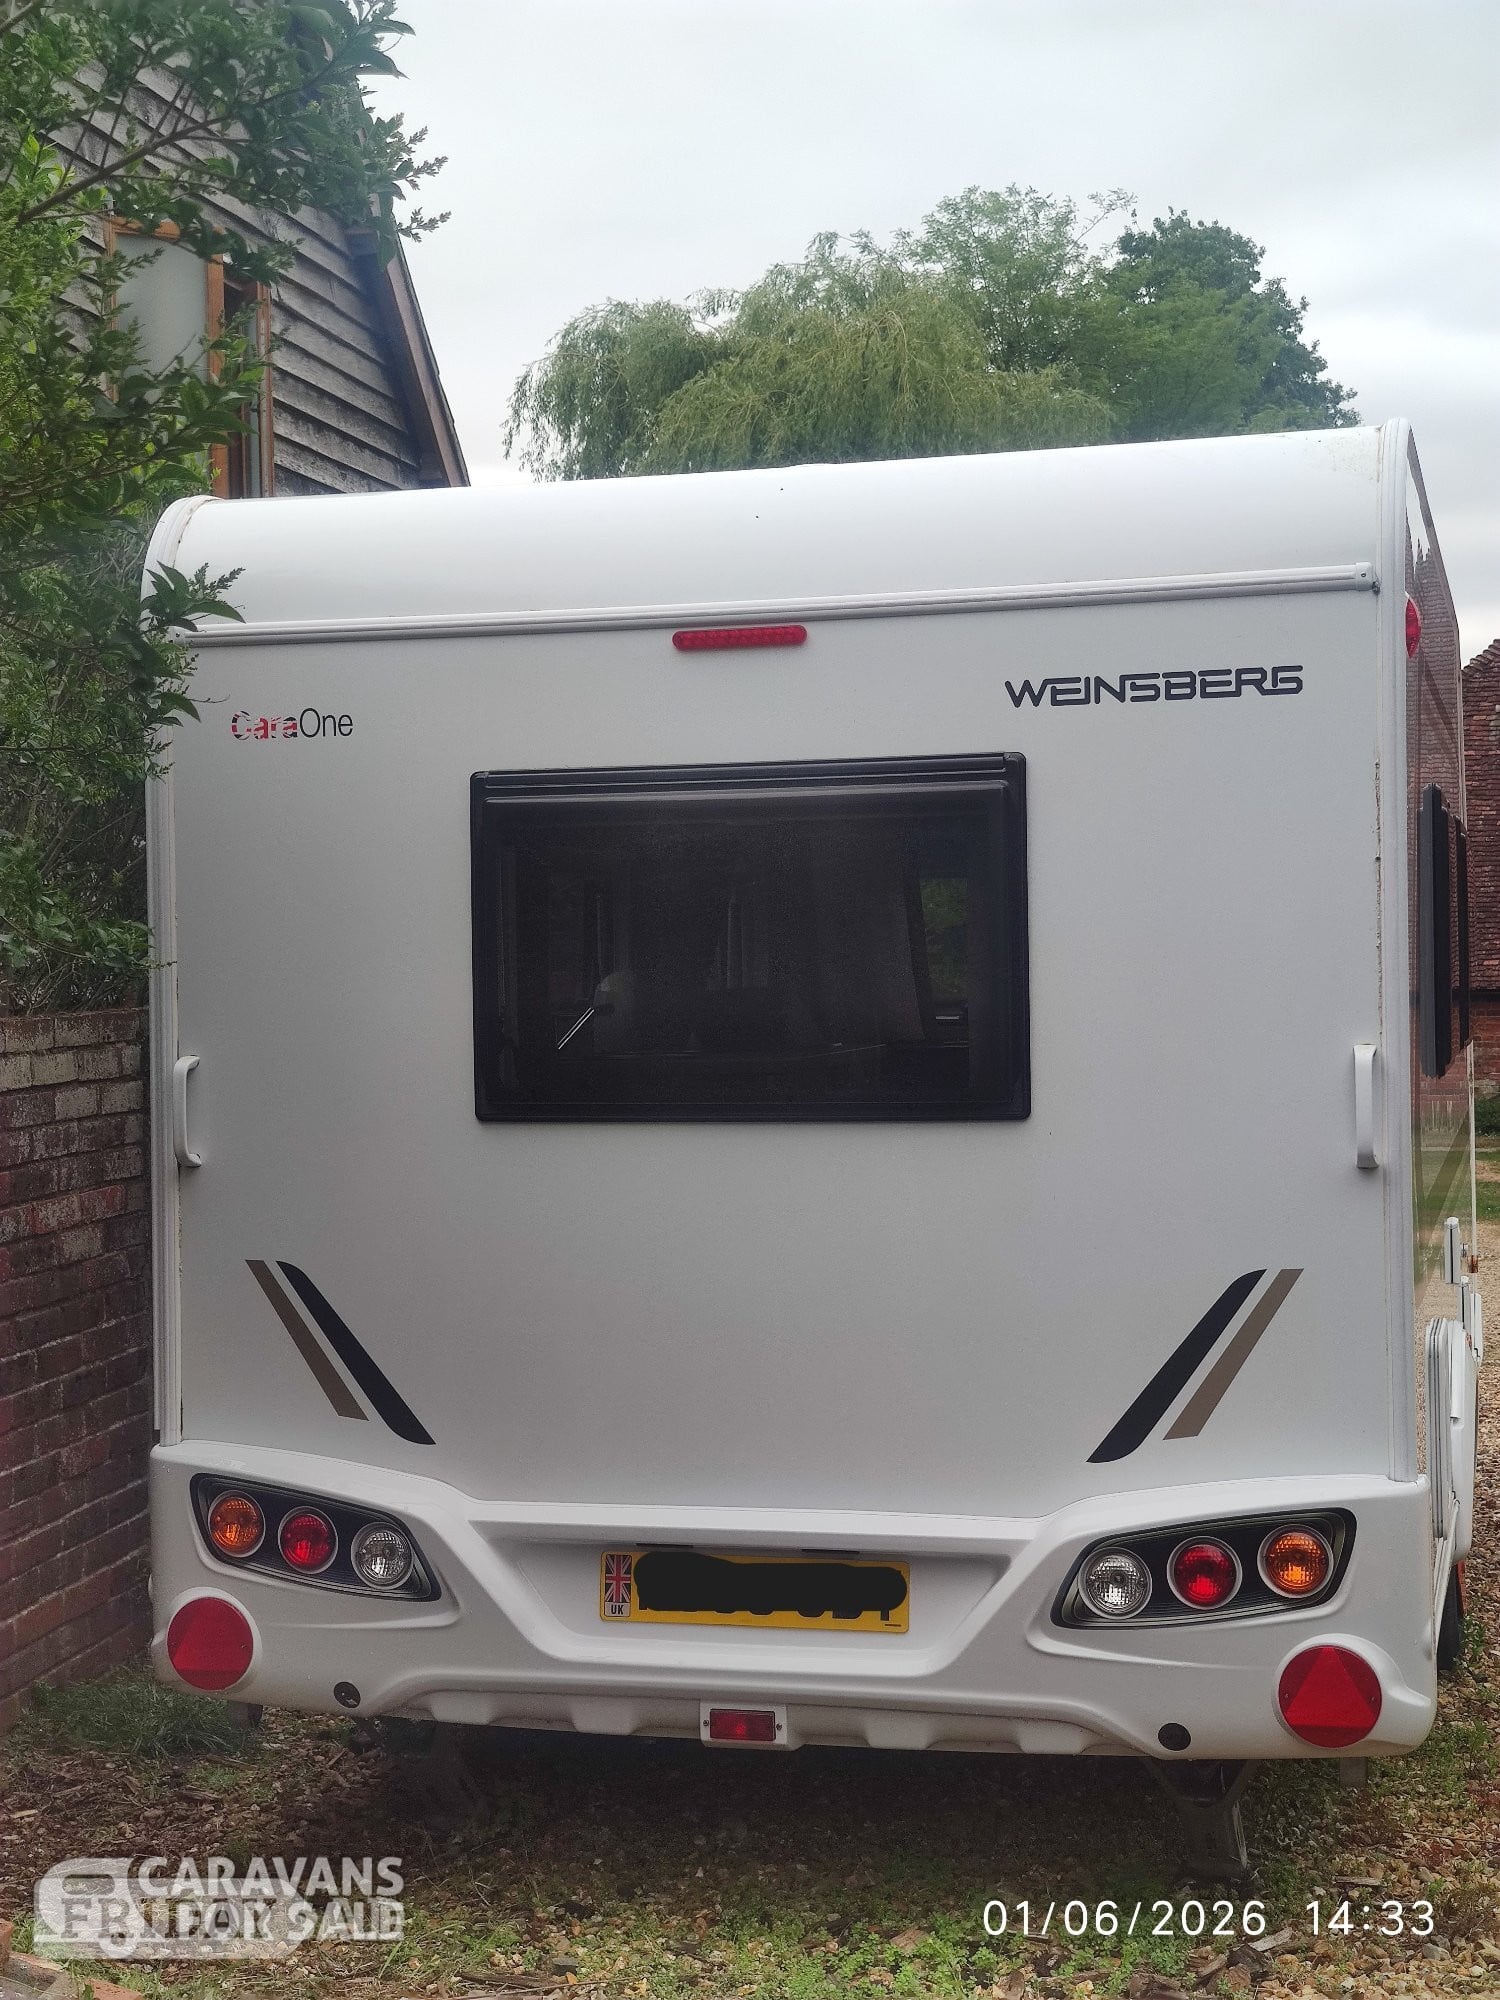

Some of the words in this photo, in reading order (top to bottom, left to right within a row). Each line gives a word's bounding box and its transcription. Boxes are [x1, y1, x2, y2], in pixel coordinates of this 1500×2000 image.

[1004, 664, 1304, 708] WEINSBERG
[231, 707, 353, 741] CaraOne
[611, 1604, 624, 1615] UK
